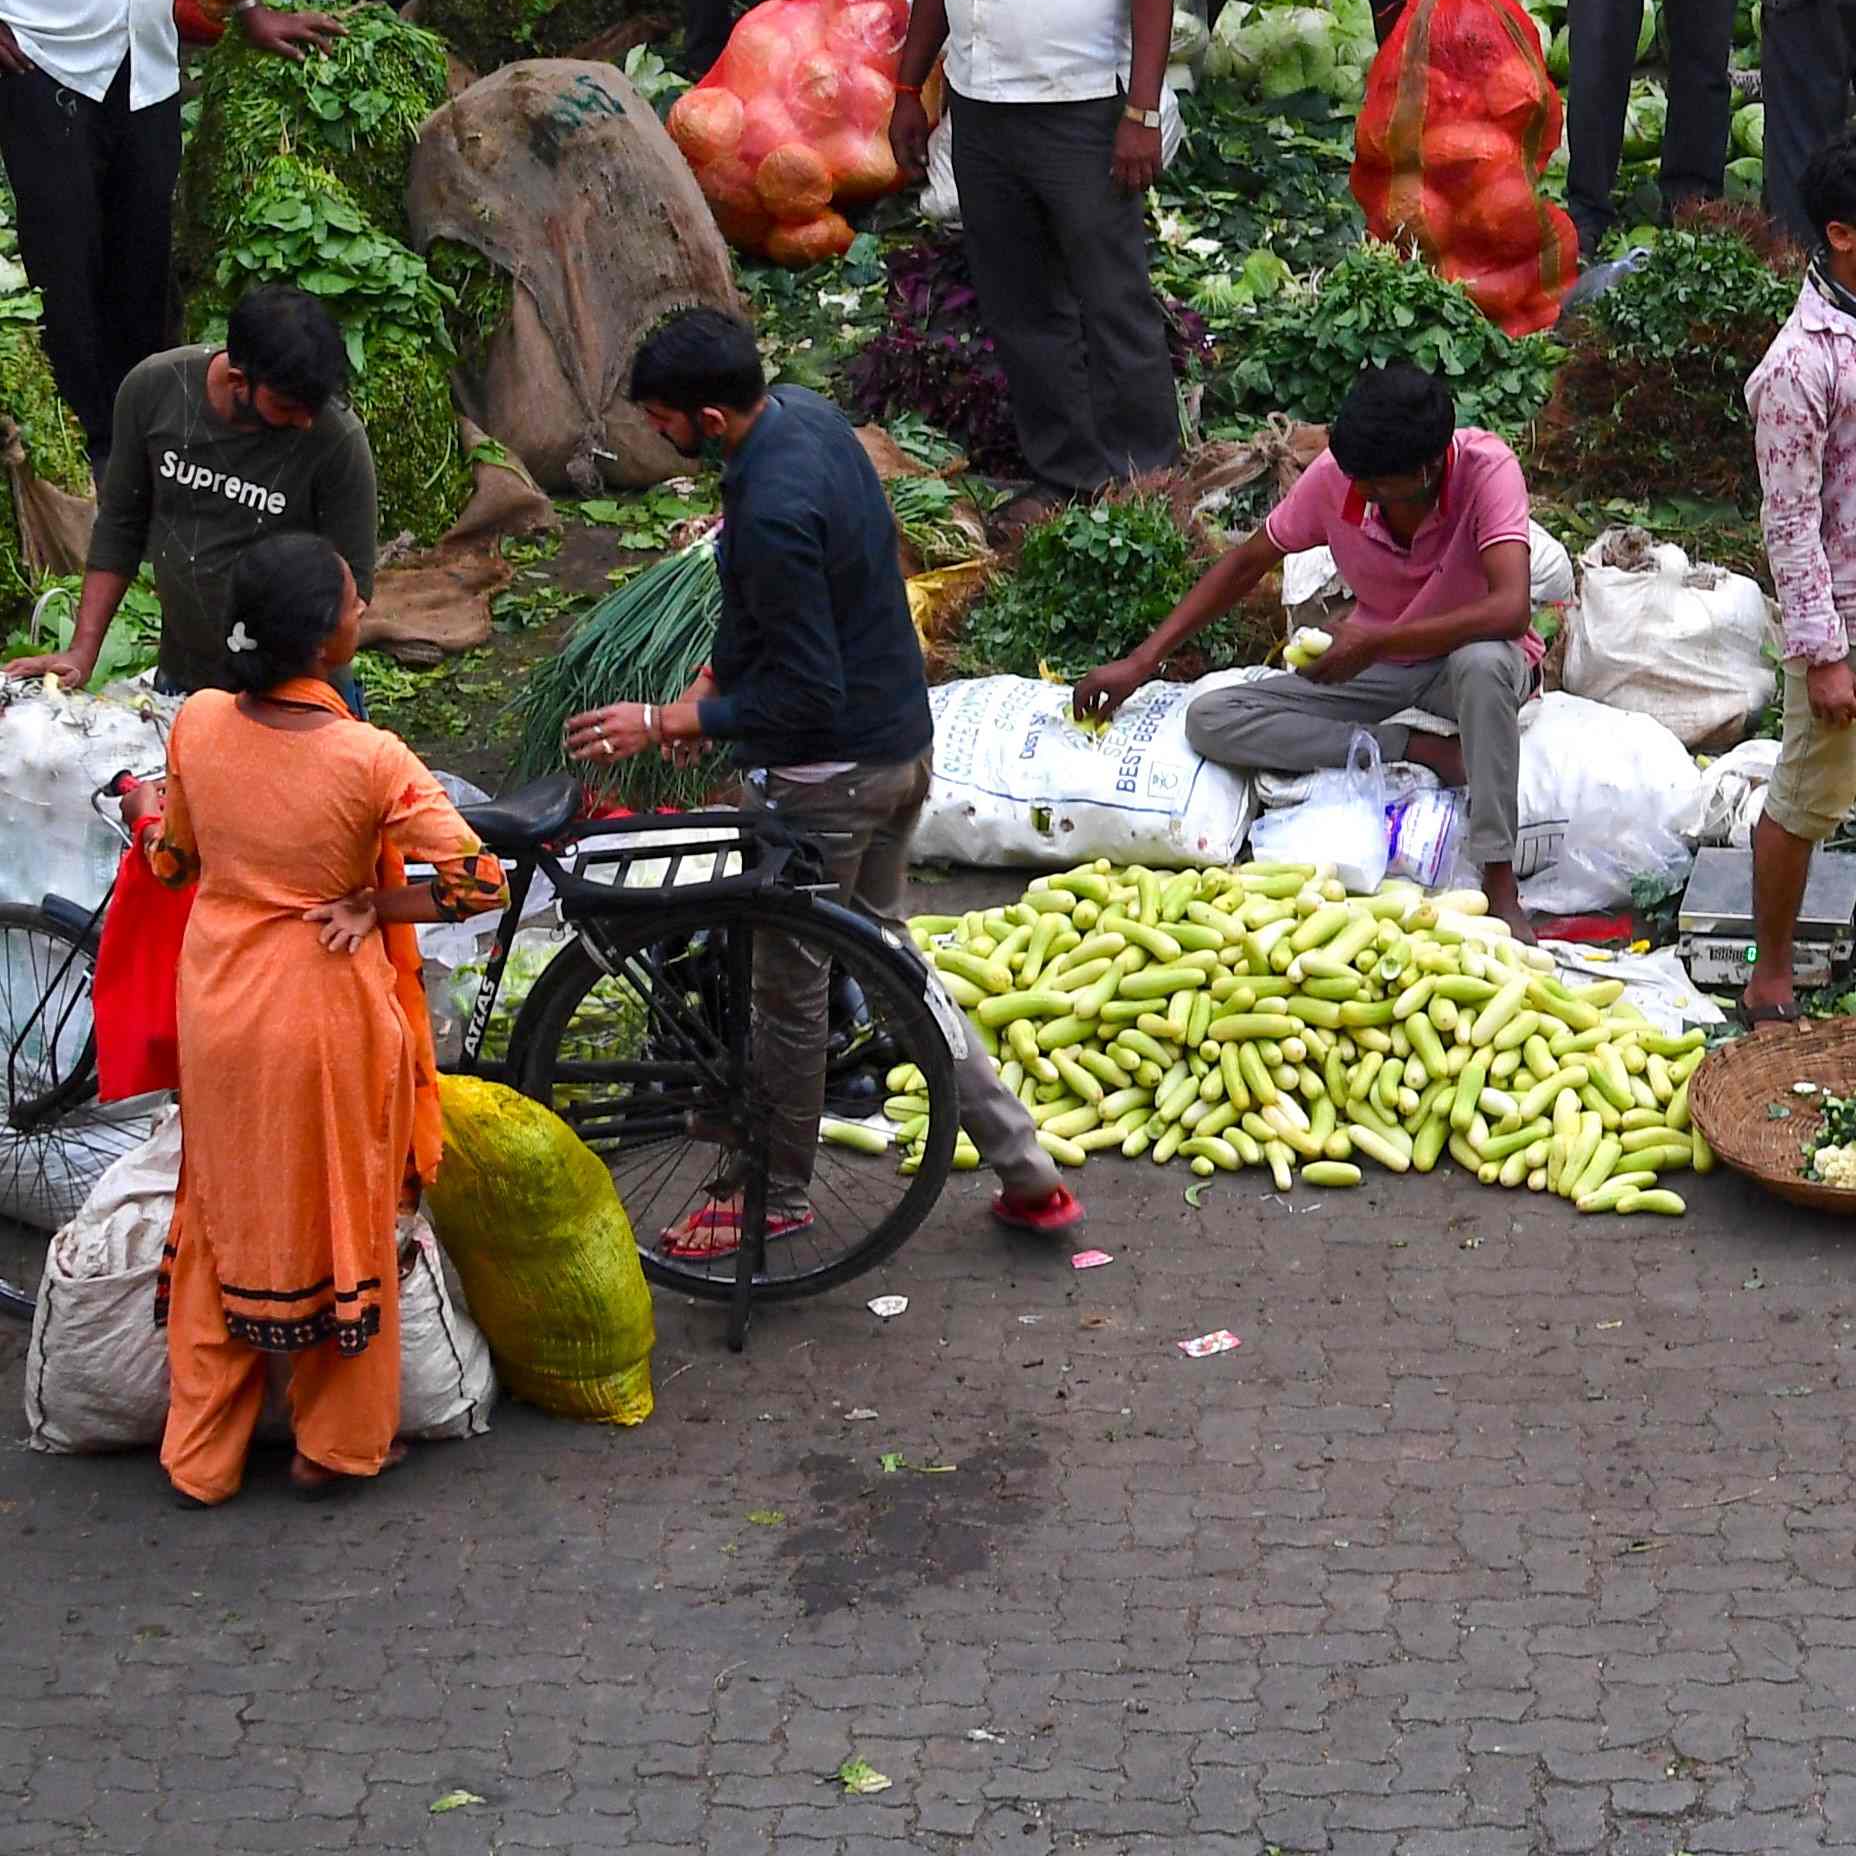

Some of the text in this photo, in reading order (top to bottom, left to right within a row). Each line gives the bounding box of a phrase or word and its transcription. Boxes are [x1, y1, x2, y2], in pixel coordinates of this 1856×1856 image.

[159, 450, 287, 515] Supreme
[1115, 745, 1147, 793] BEST
[1132, 695, 1174, 745] BEFORE
[464, 976, 495, 1057] ATLAS
